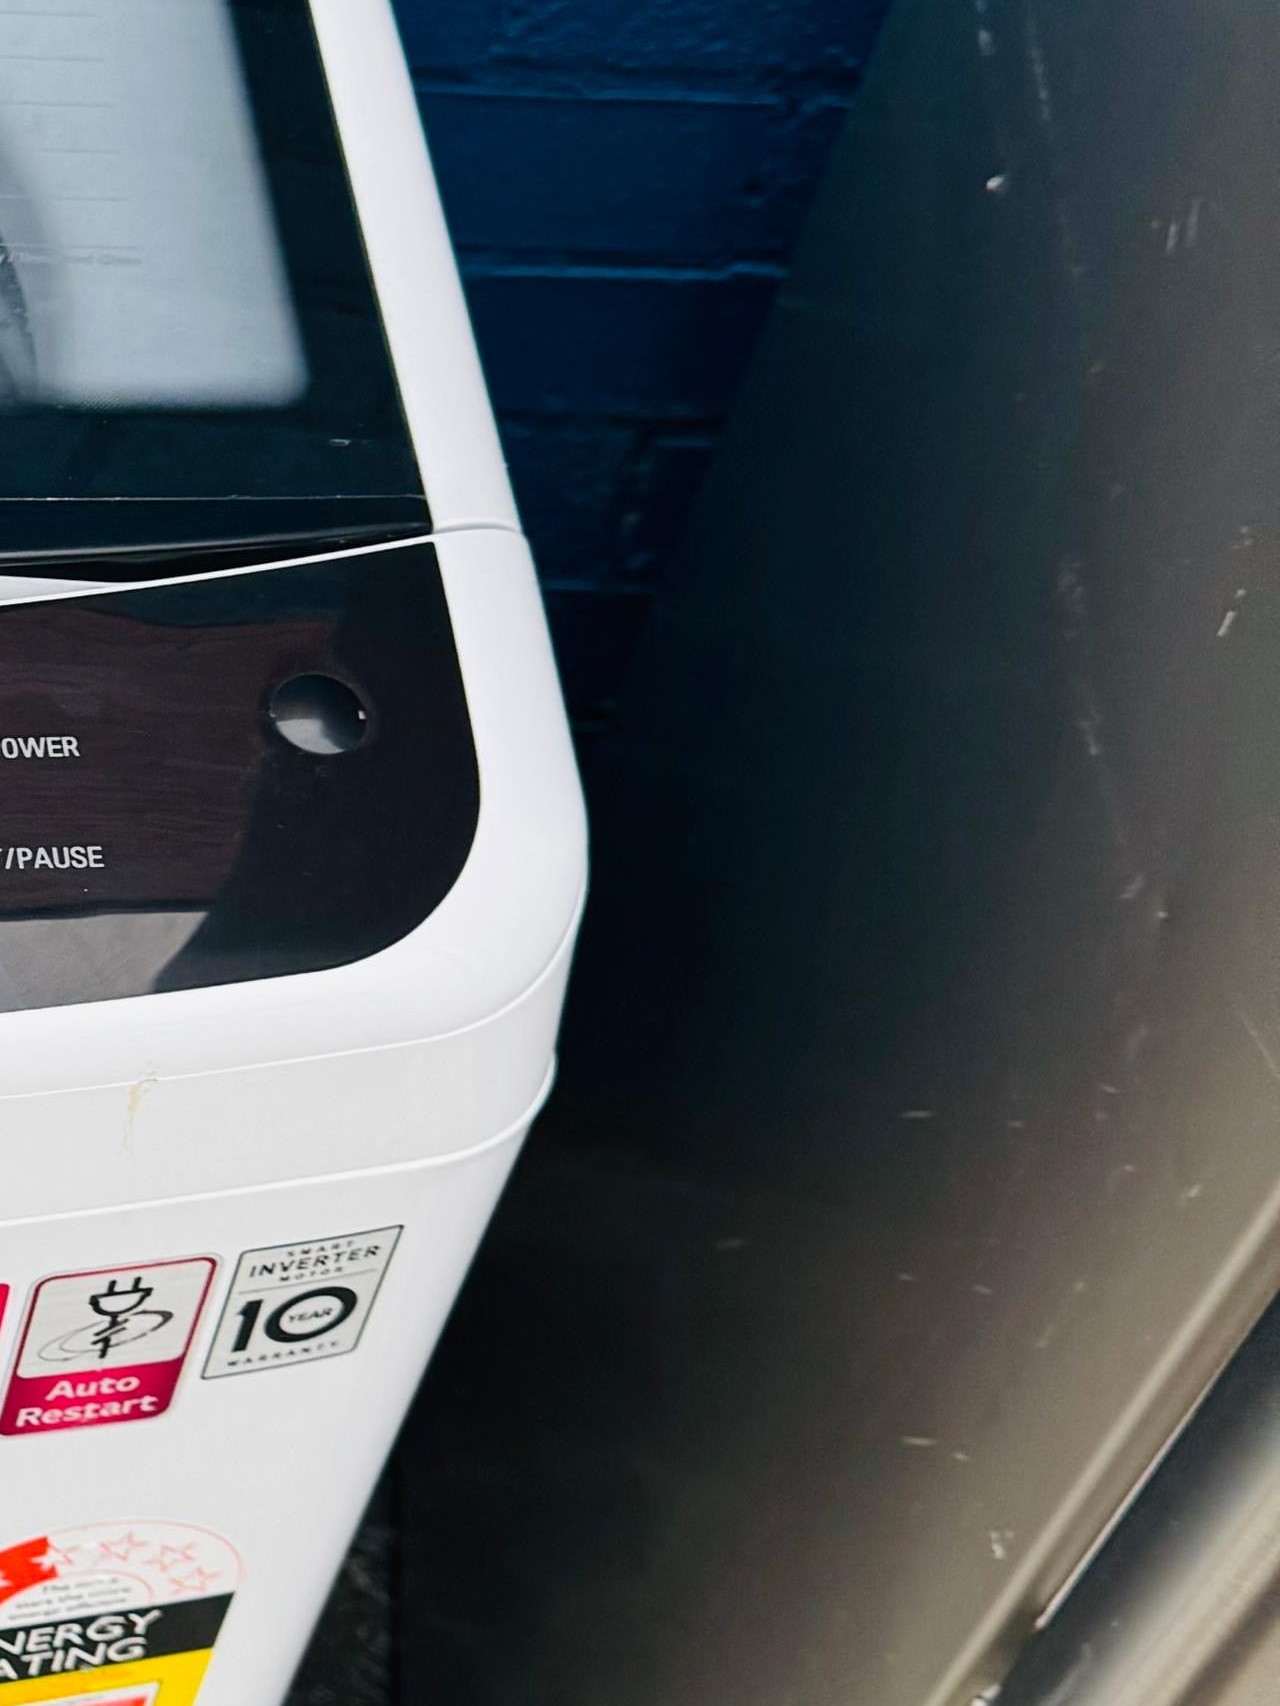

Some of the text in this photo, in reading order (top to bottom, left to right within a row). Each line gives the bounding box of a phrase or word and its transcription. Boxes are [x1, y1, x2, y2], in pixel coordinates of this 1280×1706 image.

[249, 1245, 381, 1278] INVERTER
[288, 1240, 355, 1258] SMART
[279, 1267, 345, 1282] MOTOR
[231, 1286, 358, 1353] 10
[289, 1308, 333, 1324] YEAR
[44, 1376, 141, 1402] Auto
[15, 1395, 159, 1428] Restart
